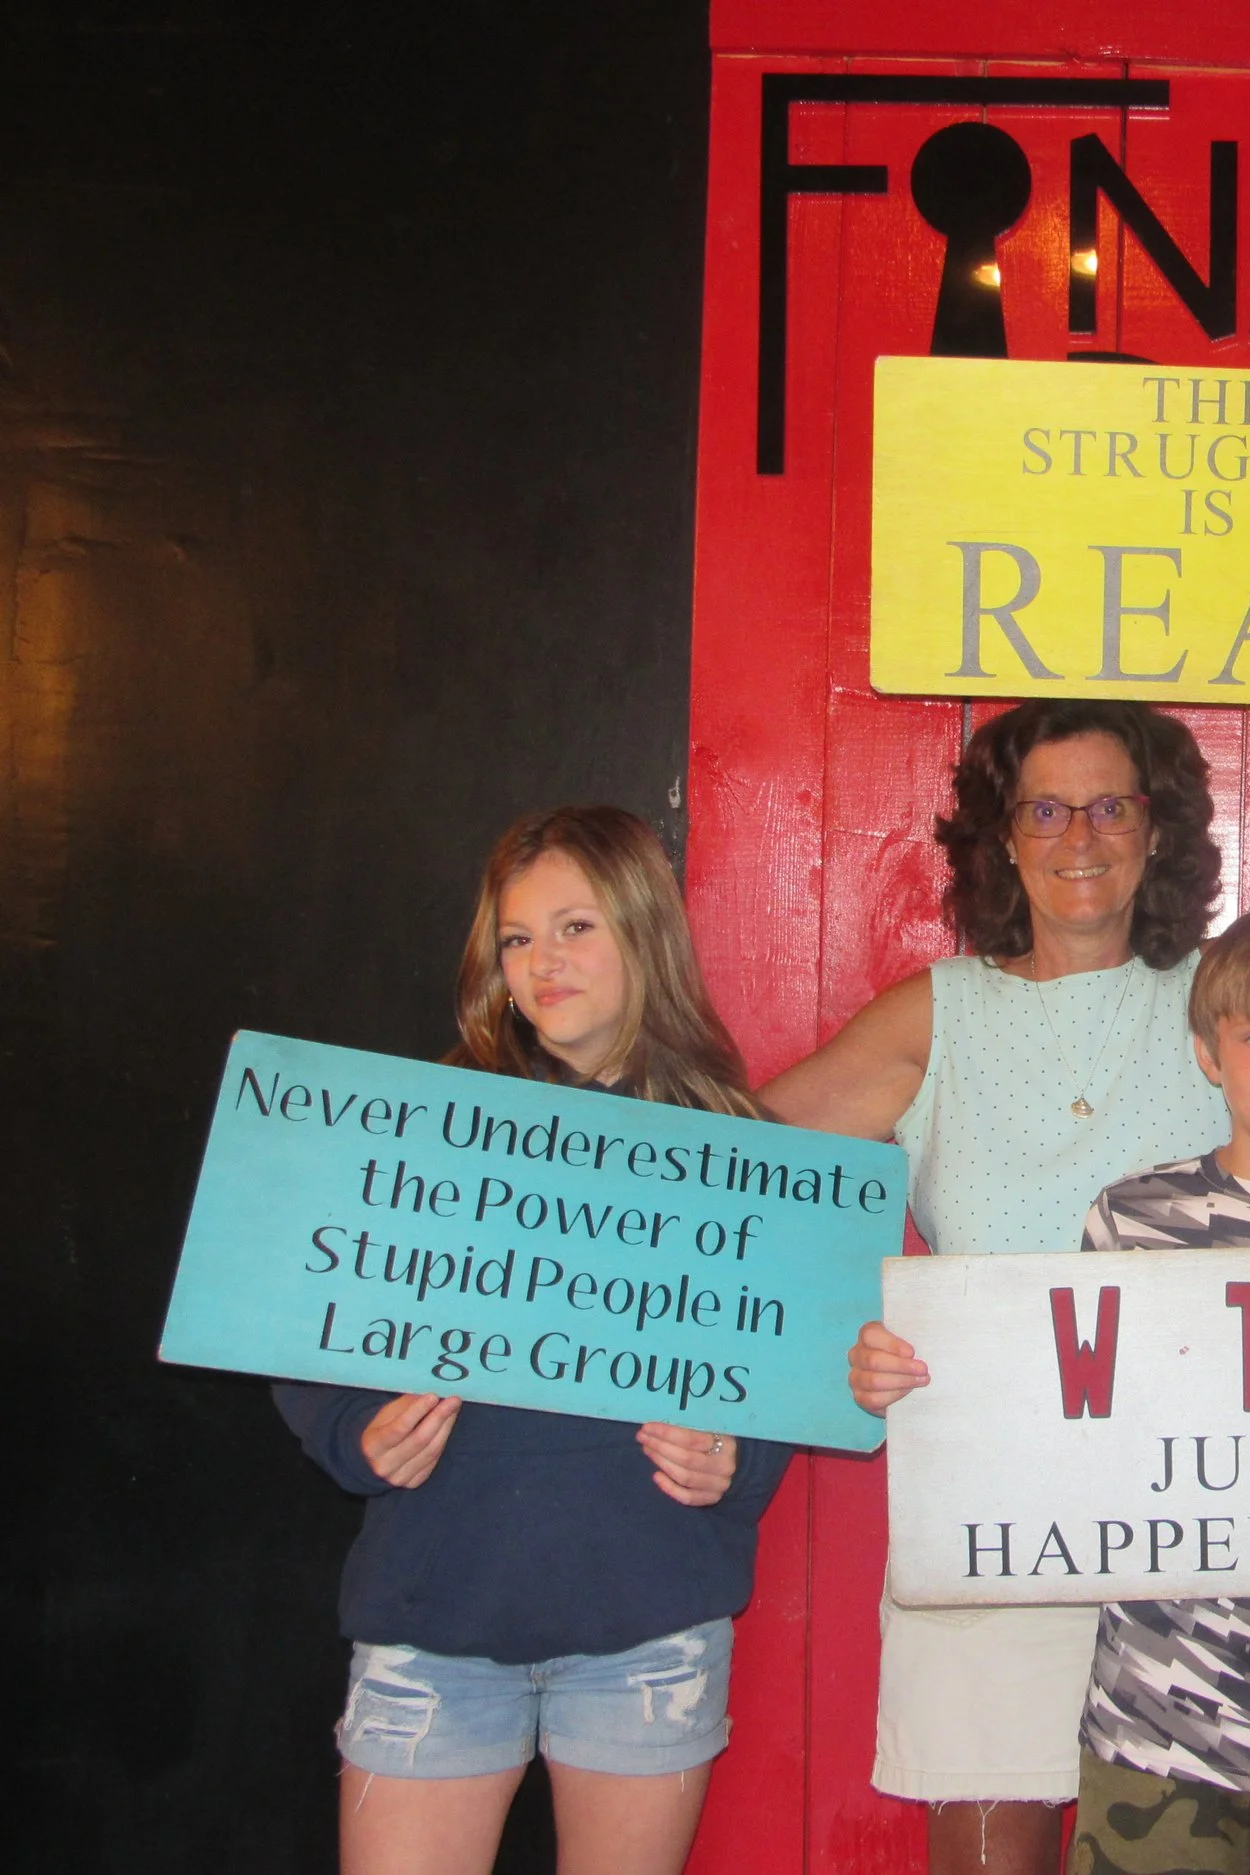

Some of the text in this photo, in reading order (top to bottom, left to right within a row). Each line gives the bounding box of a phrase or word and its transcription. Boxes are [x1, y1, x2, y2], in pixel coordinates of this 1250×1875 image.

[1180, 489, 1234, 537] IS
[235, 1067, 888, 1214] Never Underestimate
[361, 1158, 764, 1261] the Power of
[305, 1226, 785, 1336] Stupid People in
[319, 1303, 750, 1410] Large Groups
